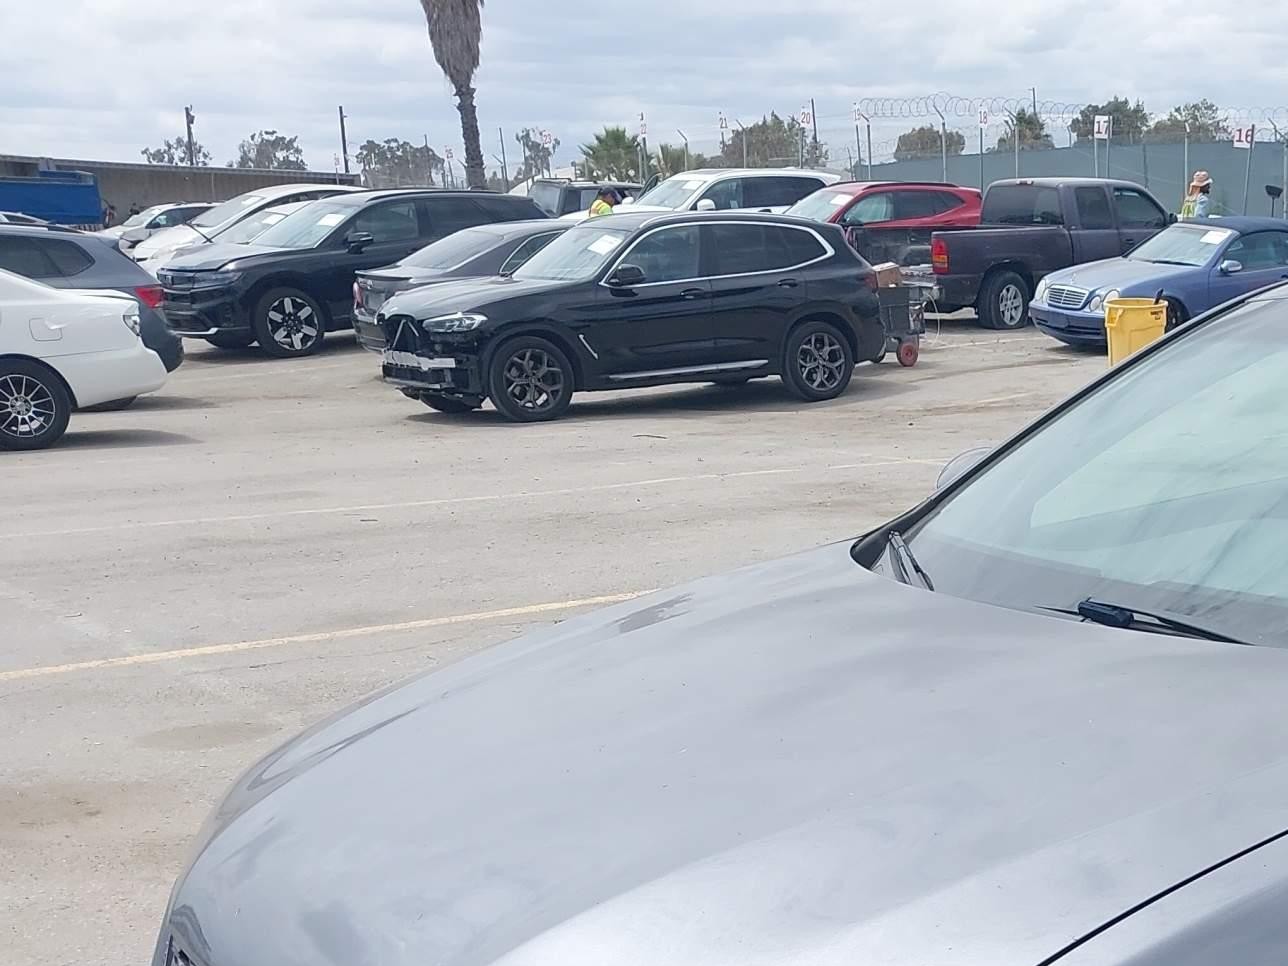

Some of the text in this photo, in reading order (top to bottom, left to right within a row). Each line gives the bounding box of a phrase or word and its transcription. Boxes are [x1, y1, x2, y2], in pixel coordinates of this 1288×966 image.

[719, 117, 728, 129] 21
[801, 112, 811, 125] 20
[979, 110, 988, 125] 18
[1095, 120, 1109, 135] 17
[1235, 128, 1253, 144] 16
